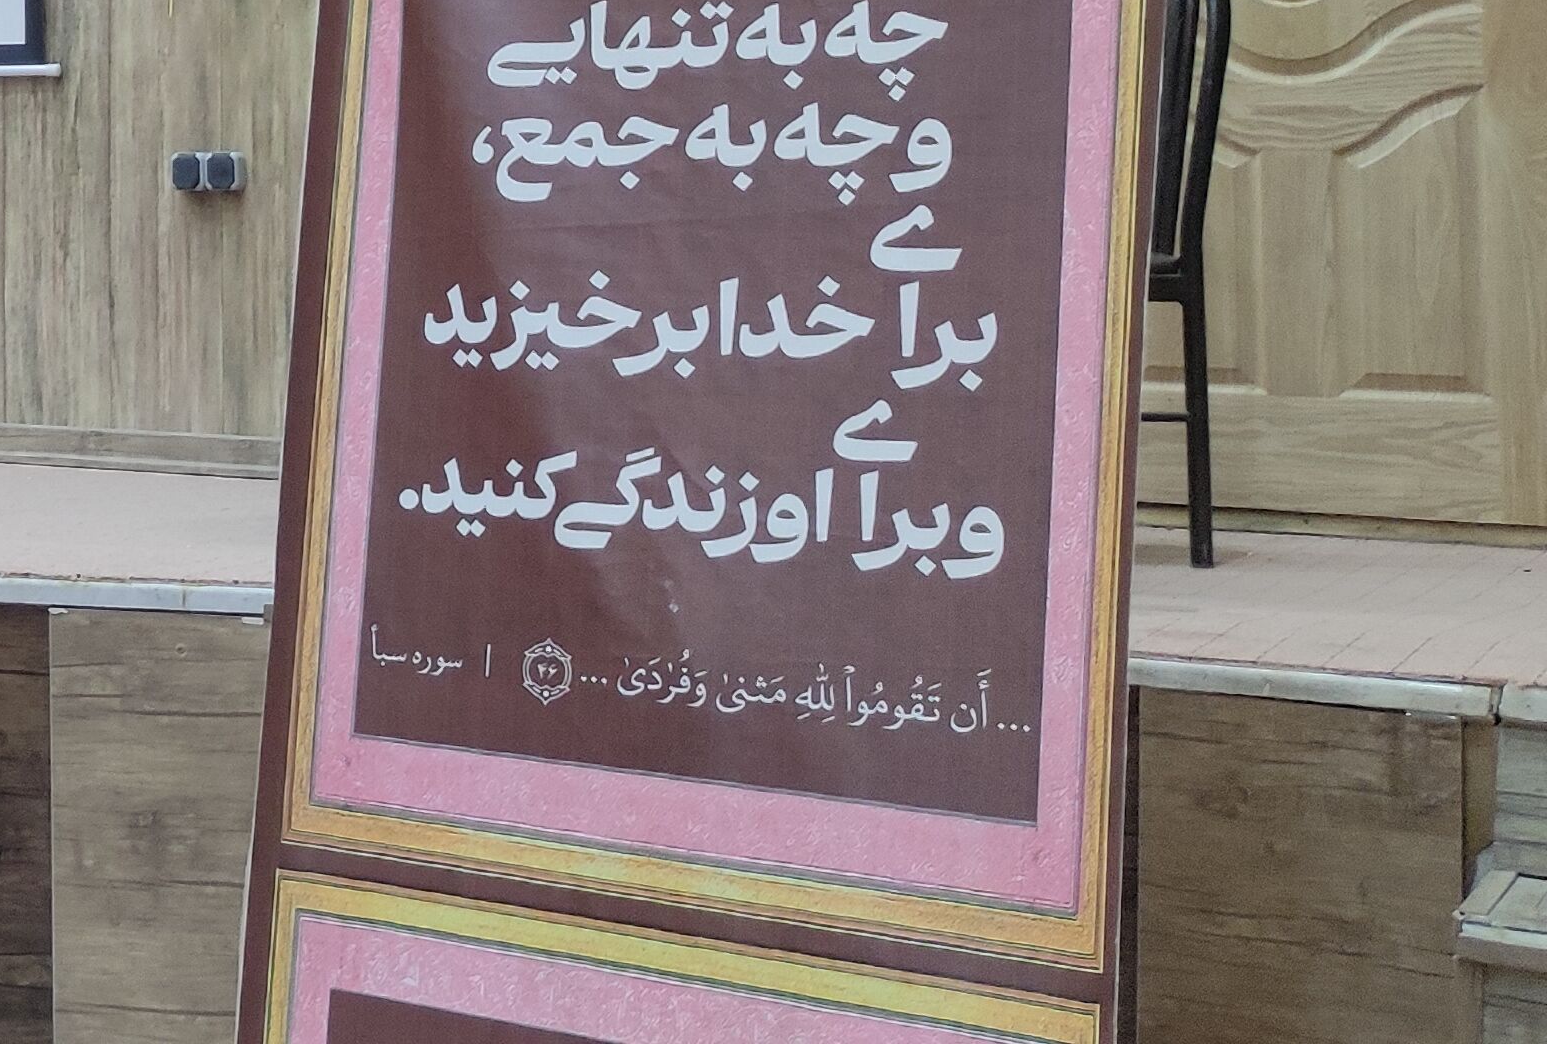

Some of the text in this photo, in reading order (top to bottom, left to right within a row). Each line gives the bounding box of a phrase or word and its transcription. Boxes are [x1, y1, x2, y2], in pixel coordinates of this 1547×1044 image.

[486, 0, 735, 91] تنهایی
[734, 2, 818, 90] به
[683, 102, 767, 191] به
[718, 274, 876, 359] خدا
[411, 649, 464, 676] سوره
